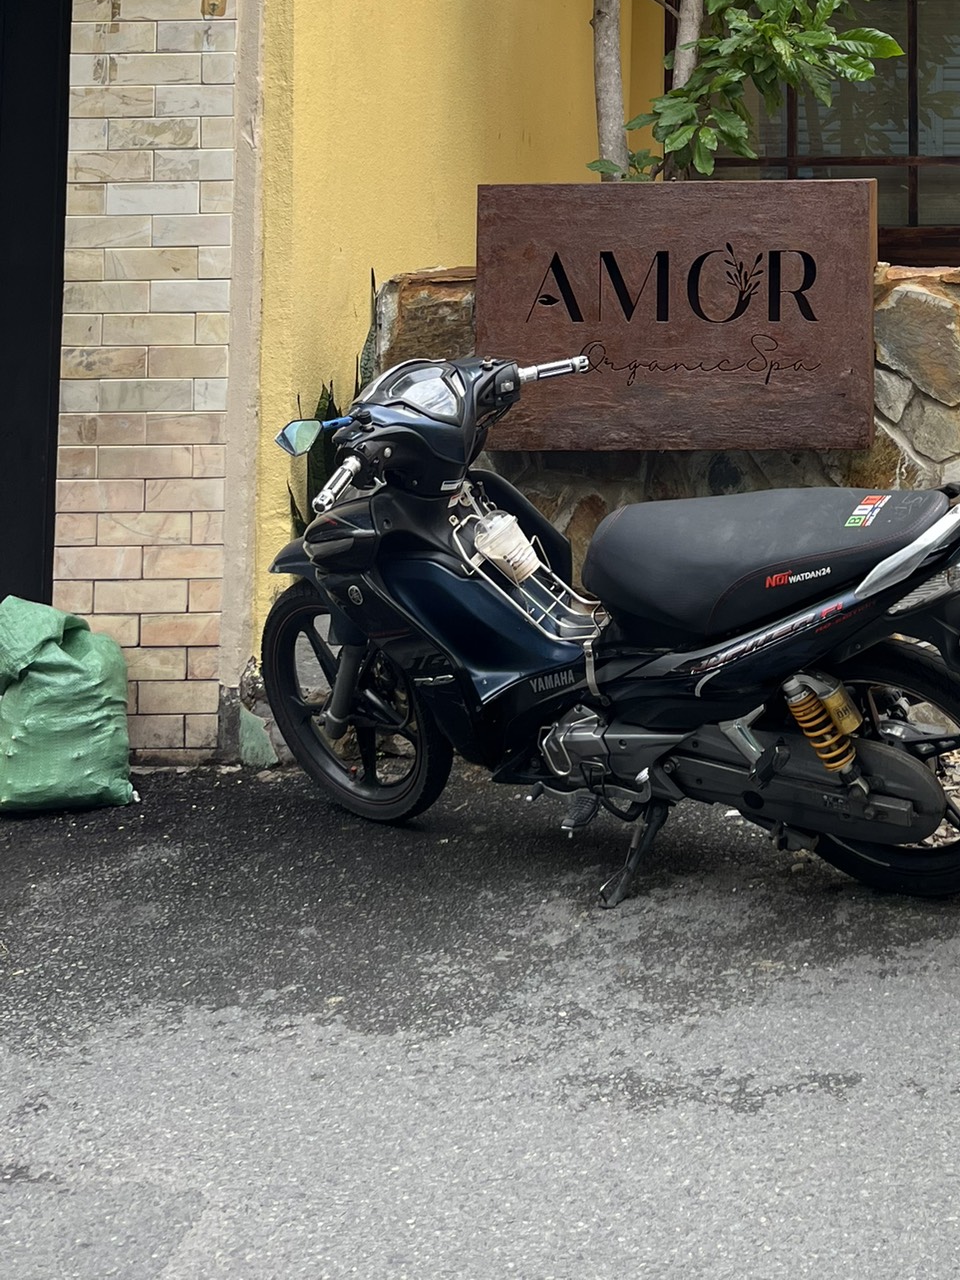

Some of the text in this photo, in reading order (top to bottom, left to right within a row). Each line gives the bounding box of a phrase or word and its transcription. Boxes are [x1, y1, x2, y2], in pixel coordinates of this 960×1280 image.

[526, 241, 819, 324] AMOR
[579, 333, 822, 386] Organic Spa
[529, 669, 576, 693] YAMAHA
